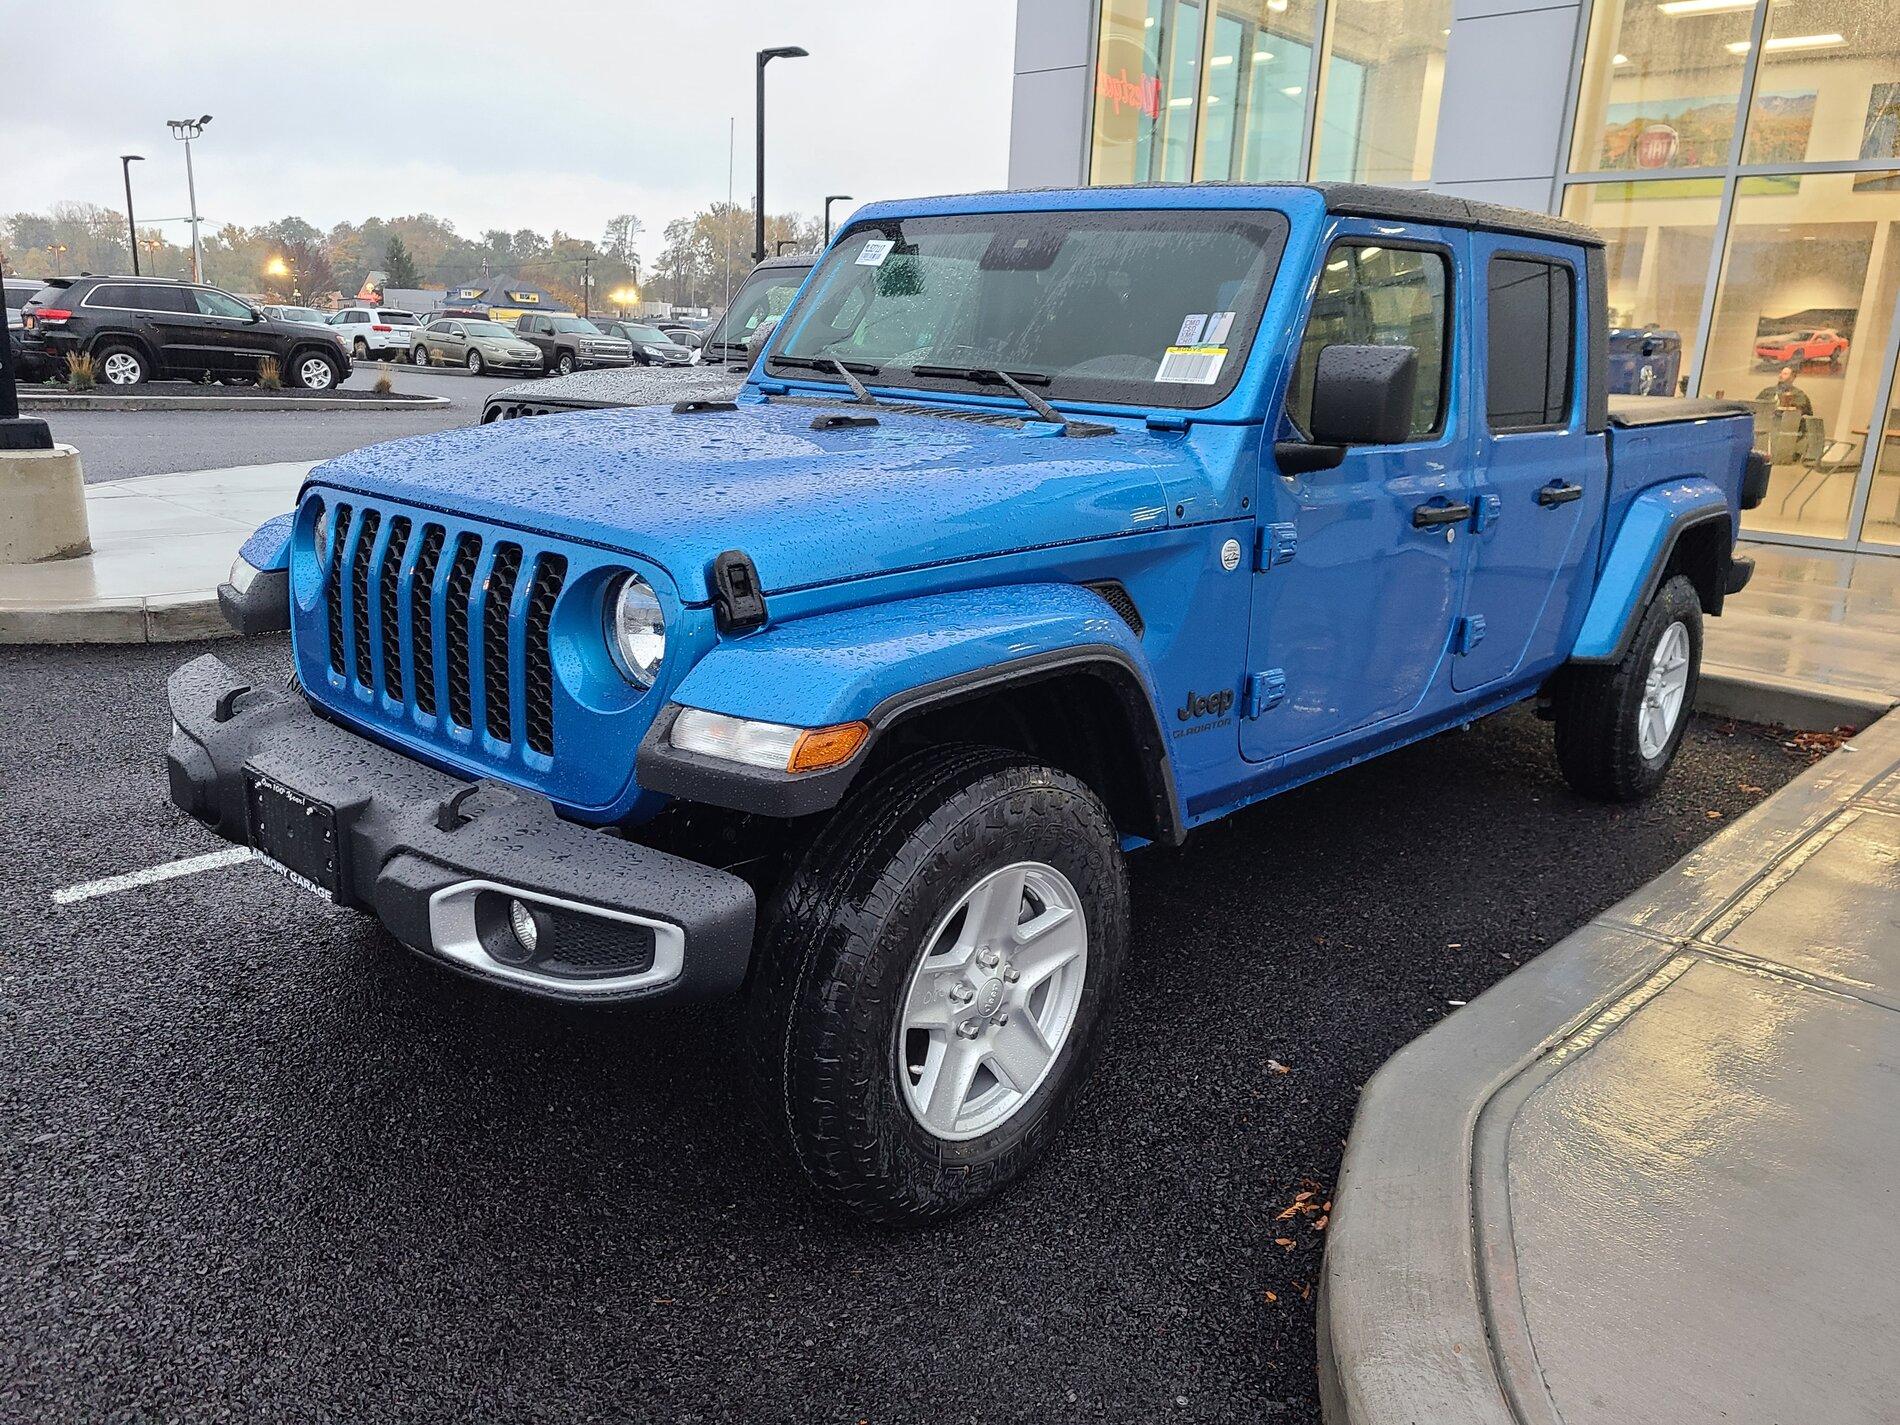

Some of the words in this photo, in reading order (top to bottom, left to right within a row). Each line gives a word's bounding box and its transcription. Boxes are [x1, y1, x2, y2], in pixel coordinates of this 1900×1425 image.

[1177, 688, 1234, 721] Jeep
[1172, 718, 1232, 739] GLADIATOR
[252, 847, 288, 877] ARMORY
[289, 871, 333, 902] GARAGE
